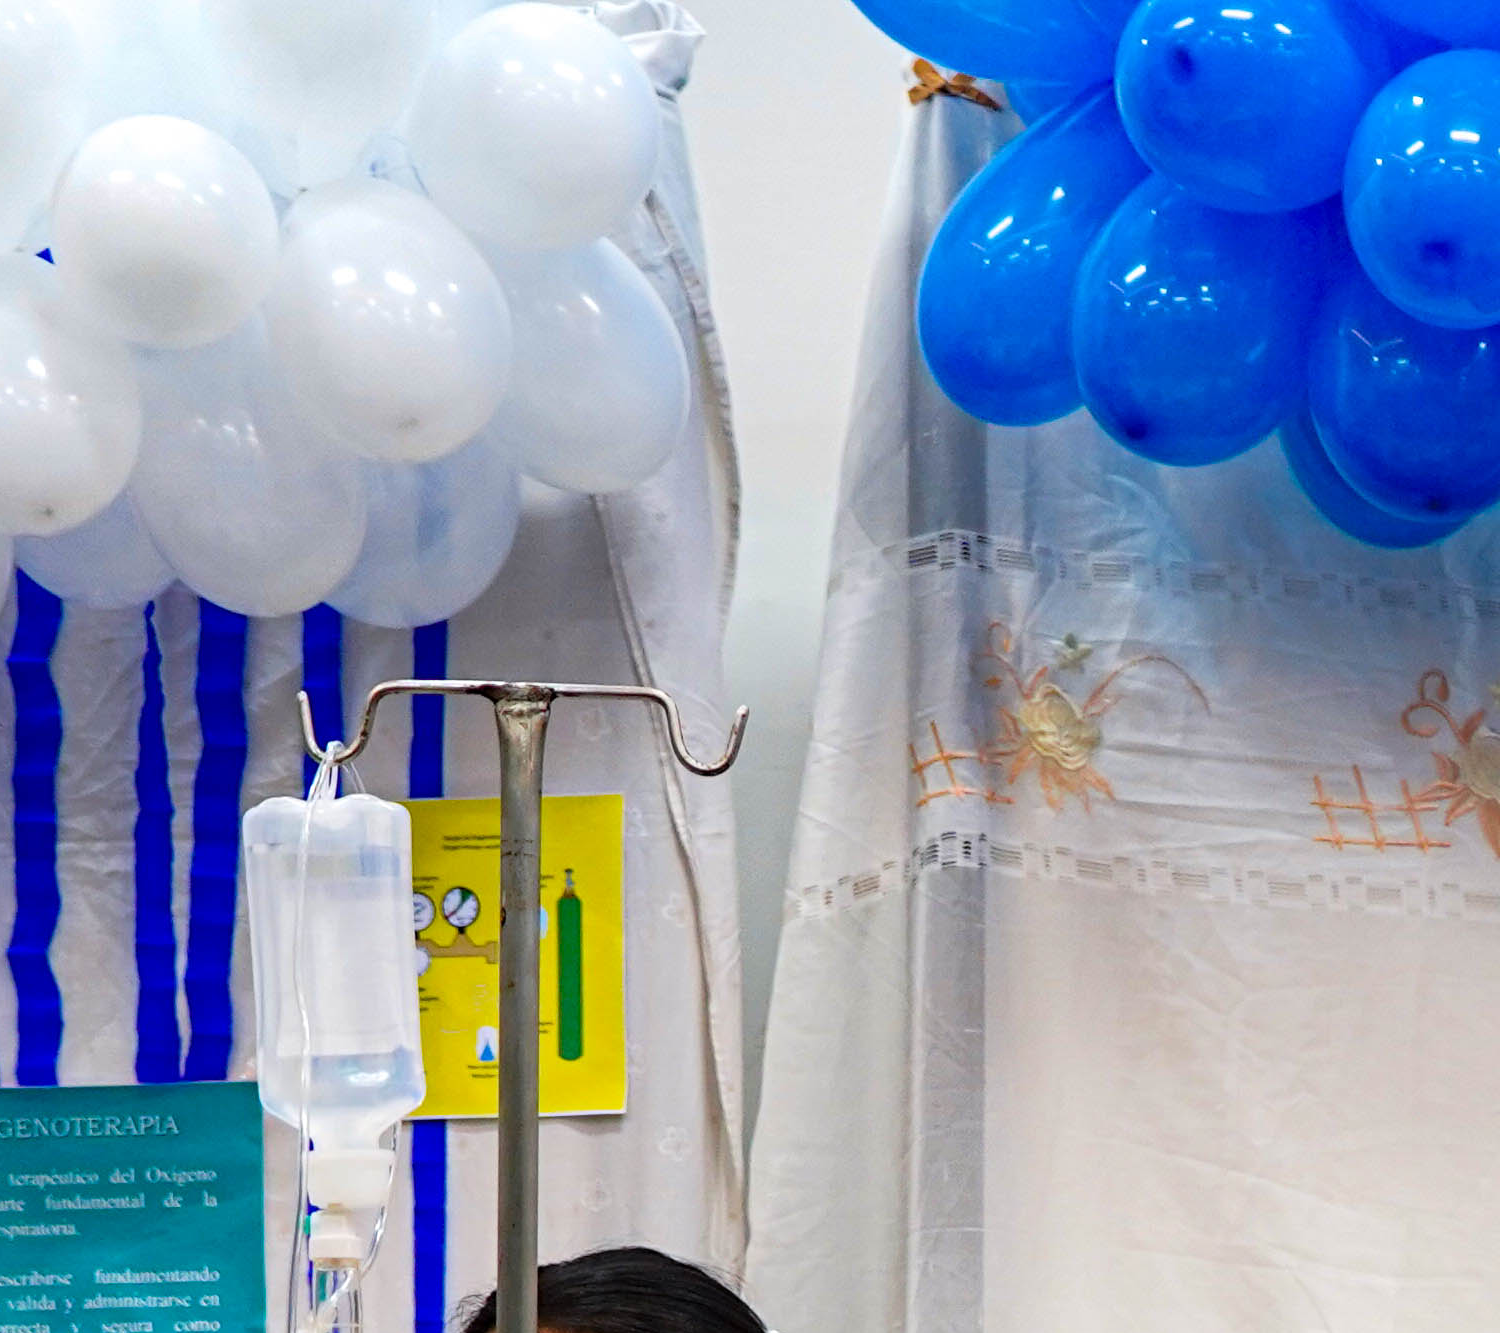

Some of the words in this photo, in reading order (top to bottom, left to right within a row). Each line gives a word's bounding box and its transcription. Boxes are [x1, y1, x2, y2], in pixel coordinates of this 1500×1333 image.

[109, 1167, 136, 1184] del
[46, 1192, 146, 1211] fundamental
[163, 1192, 183, 1208] de
[203, 1190, 218, 1207] la
[95, 1265, 221, 1284] fundamentando
[83, 1292, 192, 1309] administrarse
[199, 1294, 220, 1307] en
[173, 1320, 221, 1333] como
